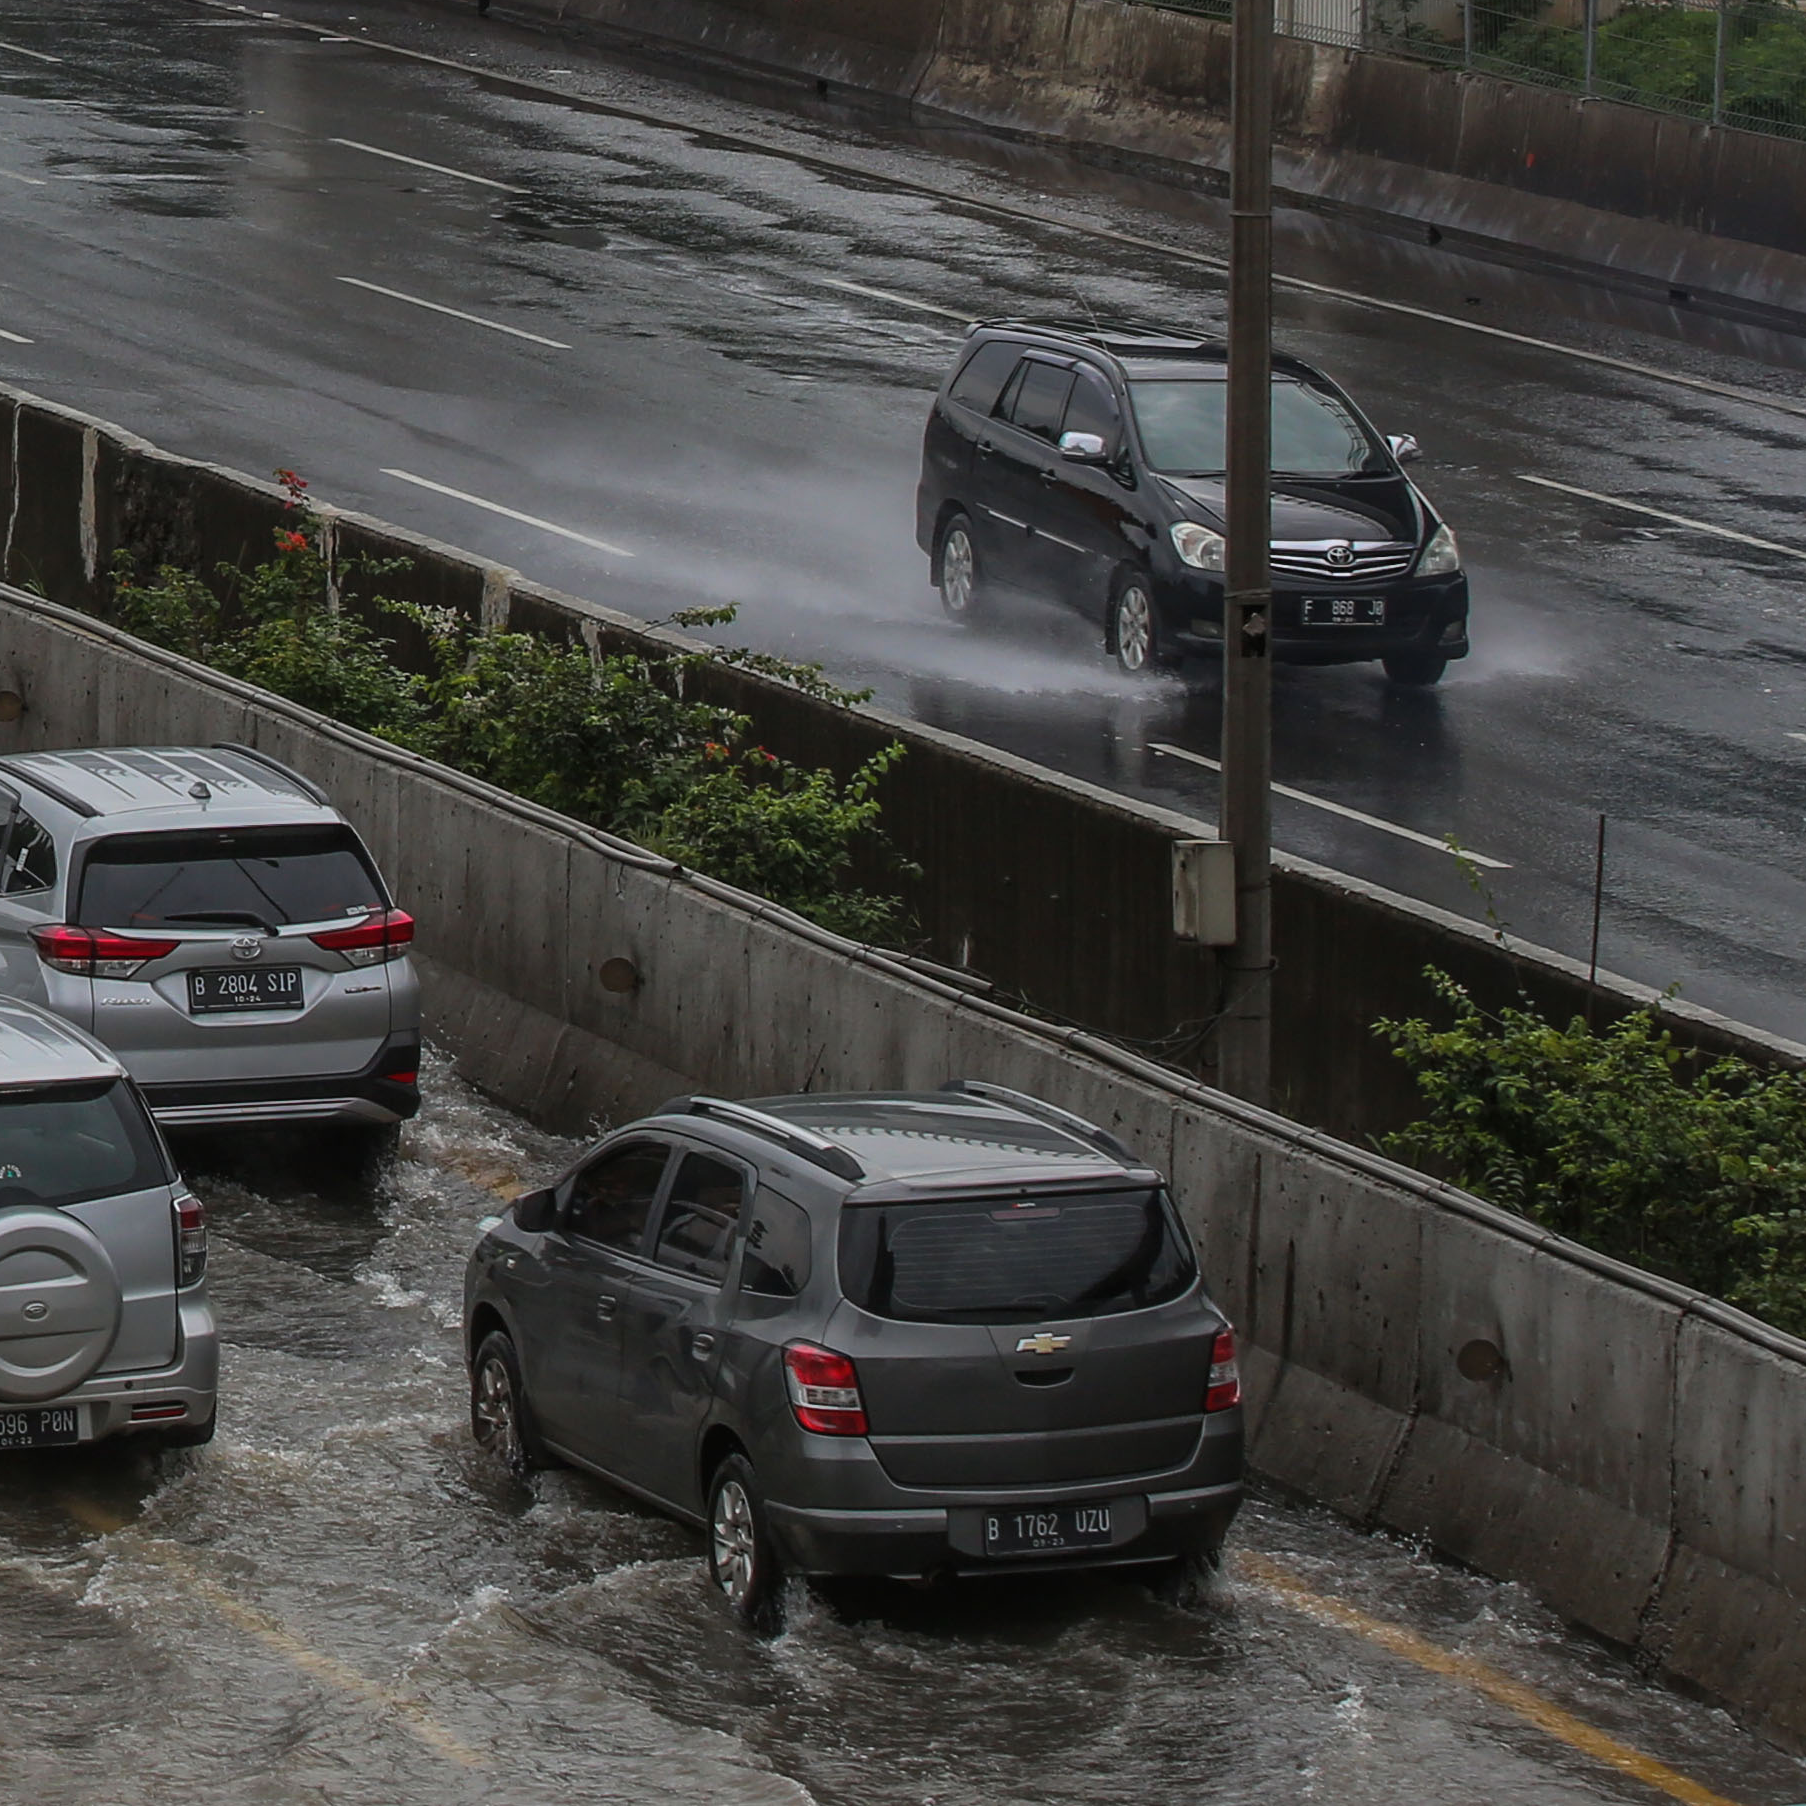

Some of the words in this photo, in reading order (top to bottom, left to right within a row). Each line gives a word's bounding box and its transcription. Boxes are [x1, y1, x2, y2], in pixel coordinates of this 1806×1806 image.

[1304, 599, 1313, 615] F
[1331, 600, 1355, 616] 868
[195, 976, 206, 996] B
[217, 974, 258, 995] 2804
[267, 972, 297, 992] SIP
[988, 1517, 999, 1540] B
[1013, 1513, 1059, 1538] 1762
[1075, 1508, 1110, 1532] UZU
